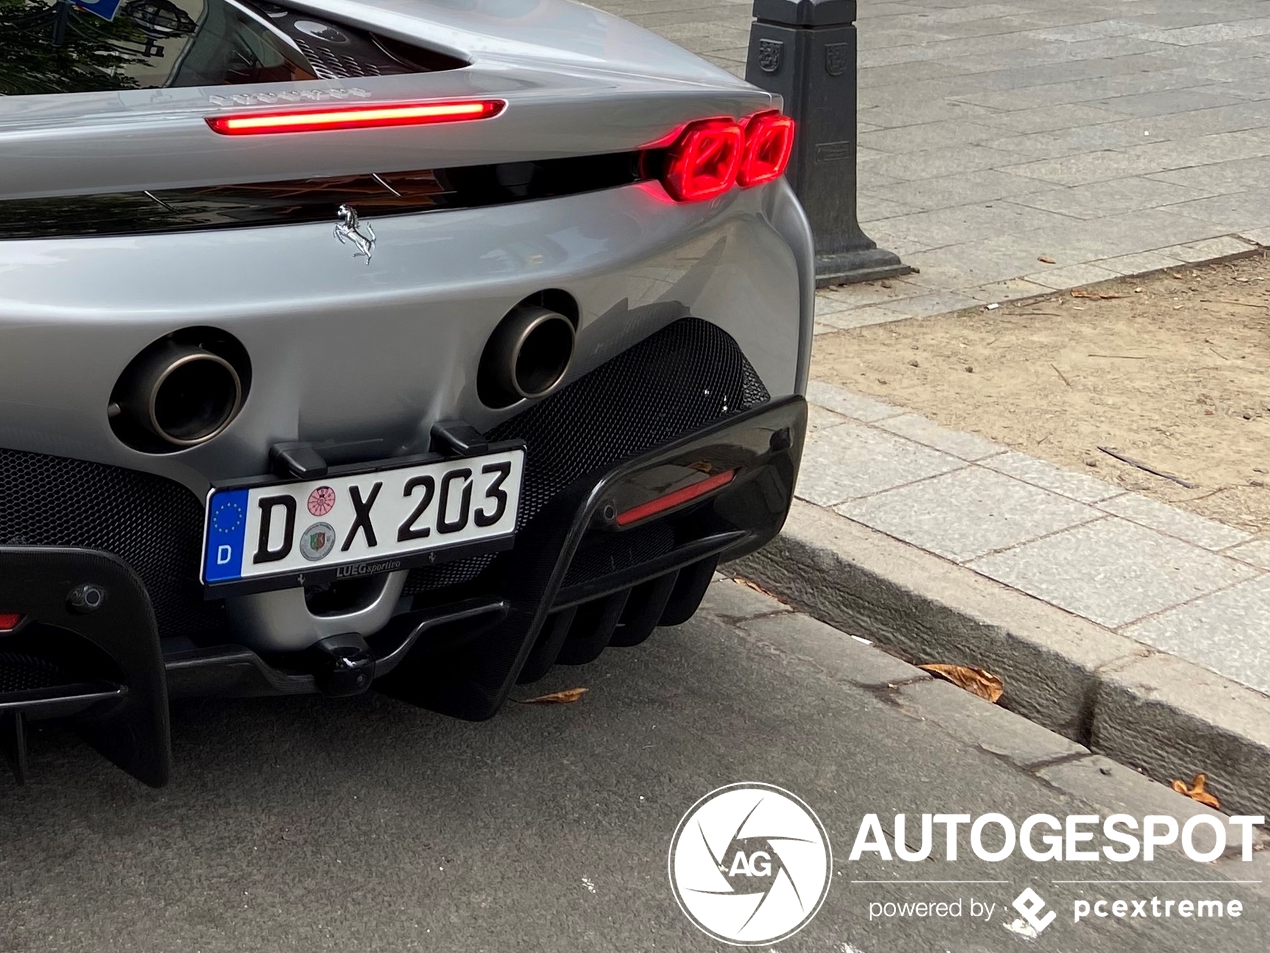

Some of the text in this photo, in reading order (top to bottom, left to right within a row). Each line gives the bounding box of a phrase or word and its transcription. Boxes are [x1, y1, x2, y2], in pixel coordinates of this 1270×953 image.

[252, 494, 297, 565] D
[341, 481, 384, 552] X
[397, 460, 512, 543] 203
[217, 544, 232, 565] D
